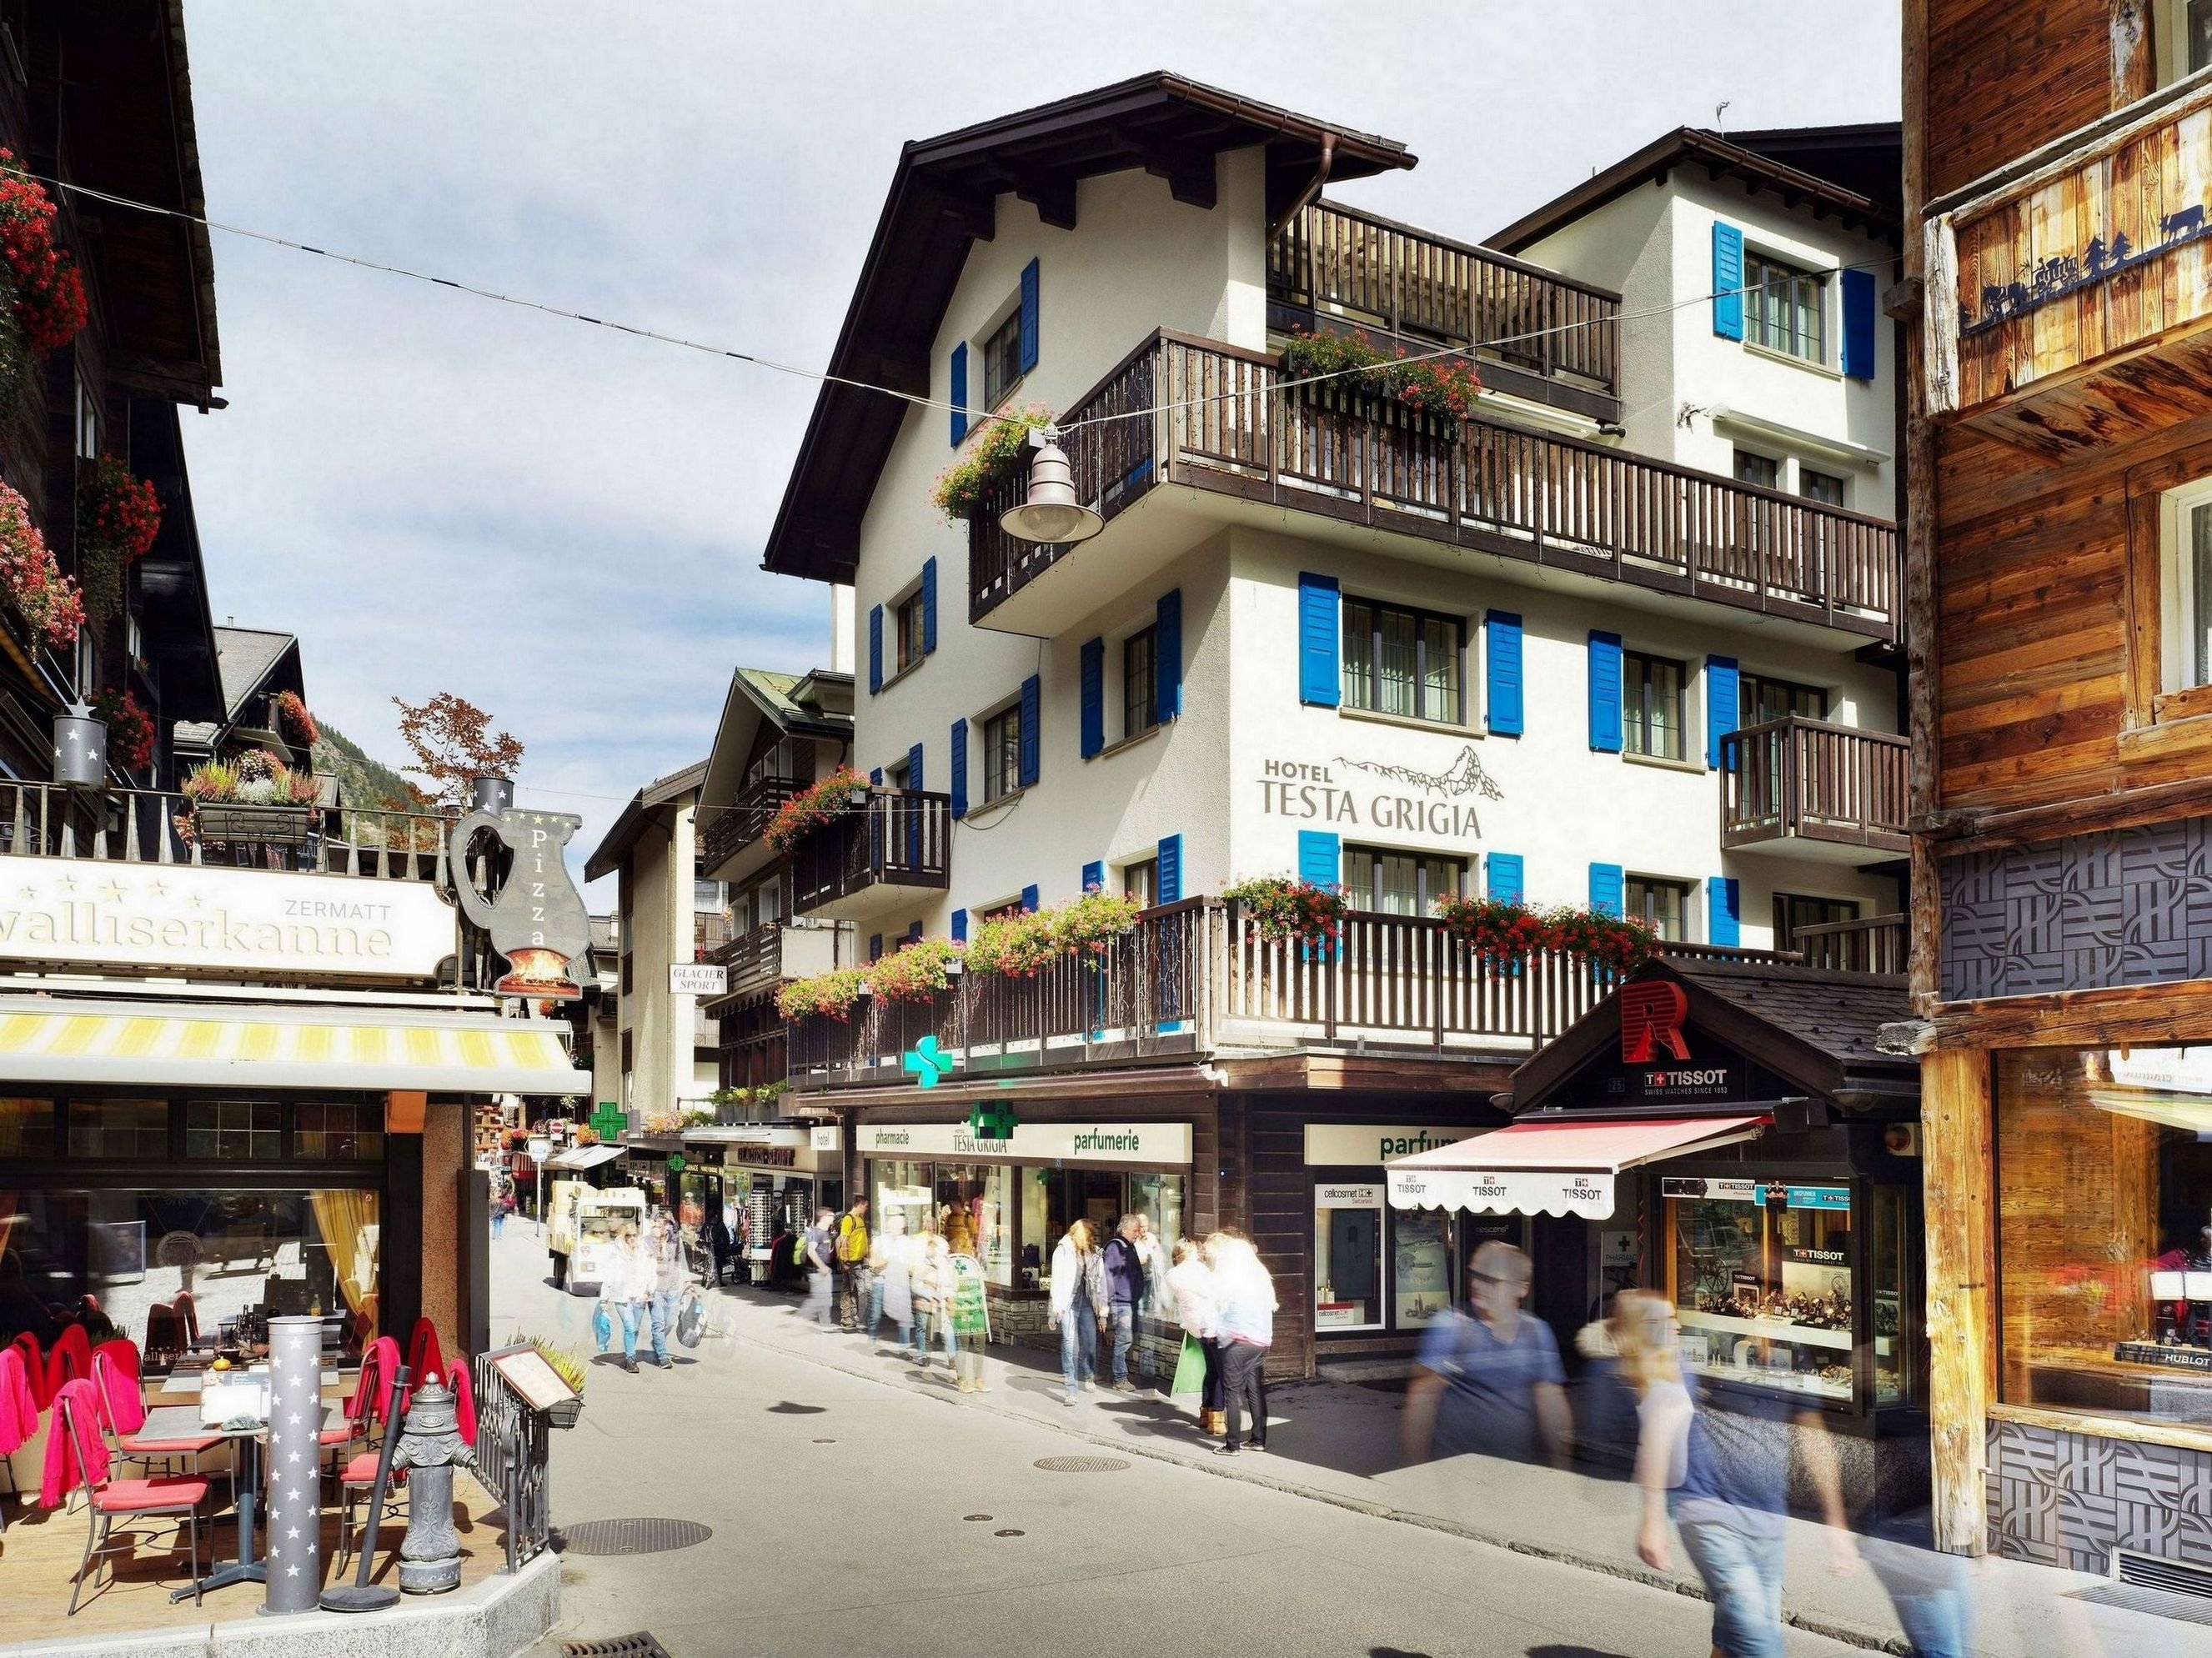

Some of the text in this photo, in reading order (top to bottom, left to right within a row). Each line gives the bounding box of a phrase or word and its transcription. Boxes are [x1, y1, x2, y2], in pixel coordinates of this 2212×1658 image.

[1265, 759, 1333, 784] HOTEL
[1256, 779, 1482, 839] TESTA GRIGIA
[531, 829, 547, 946] Pizza
[285, 899, 392, 921] ZERMATT
[673, 968, 724, 979] GLACIER
[680, 979, 717, 990] SPORT
[1667, 1069, 1728, 1085] TISSOT
[816, 1131, 830, 1145] hotel
[875, 1128, 910, 1148] pharmacie
[1074, 1127, 1140, 1155] parfumerie
[1324, 1189, 1357, 1199] cellcosmet
[1397, 1185, 1427, 1194] TISSOT
[1472, 1186, 1507, 1196] TISSOT
[1562, 1189, 1602, 1200] TISSOT
[1807, 1250, 1844, 1261] TISSOT
[2164, 1353, 2210, 1367] HUBLOT
